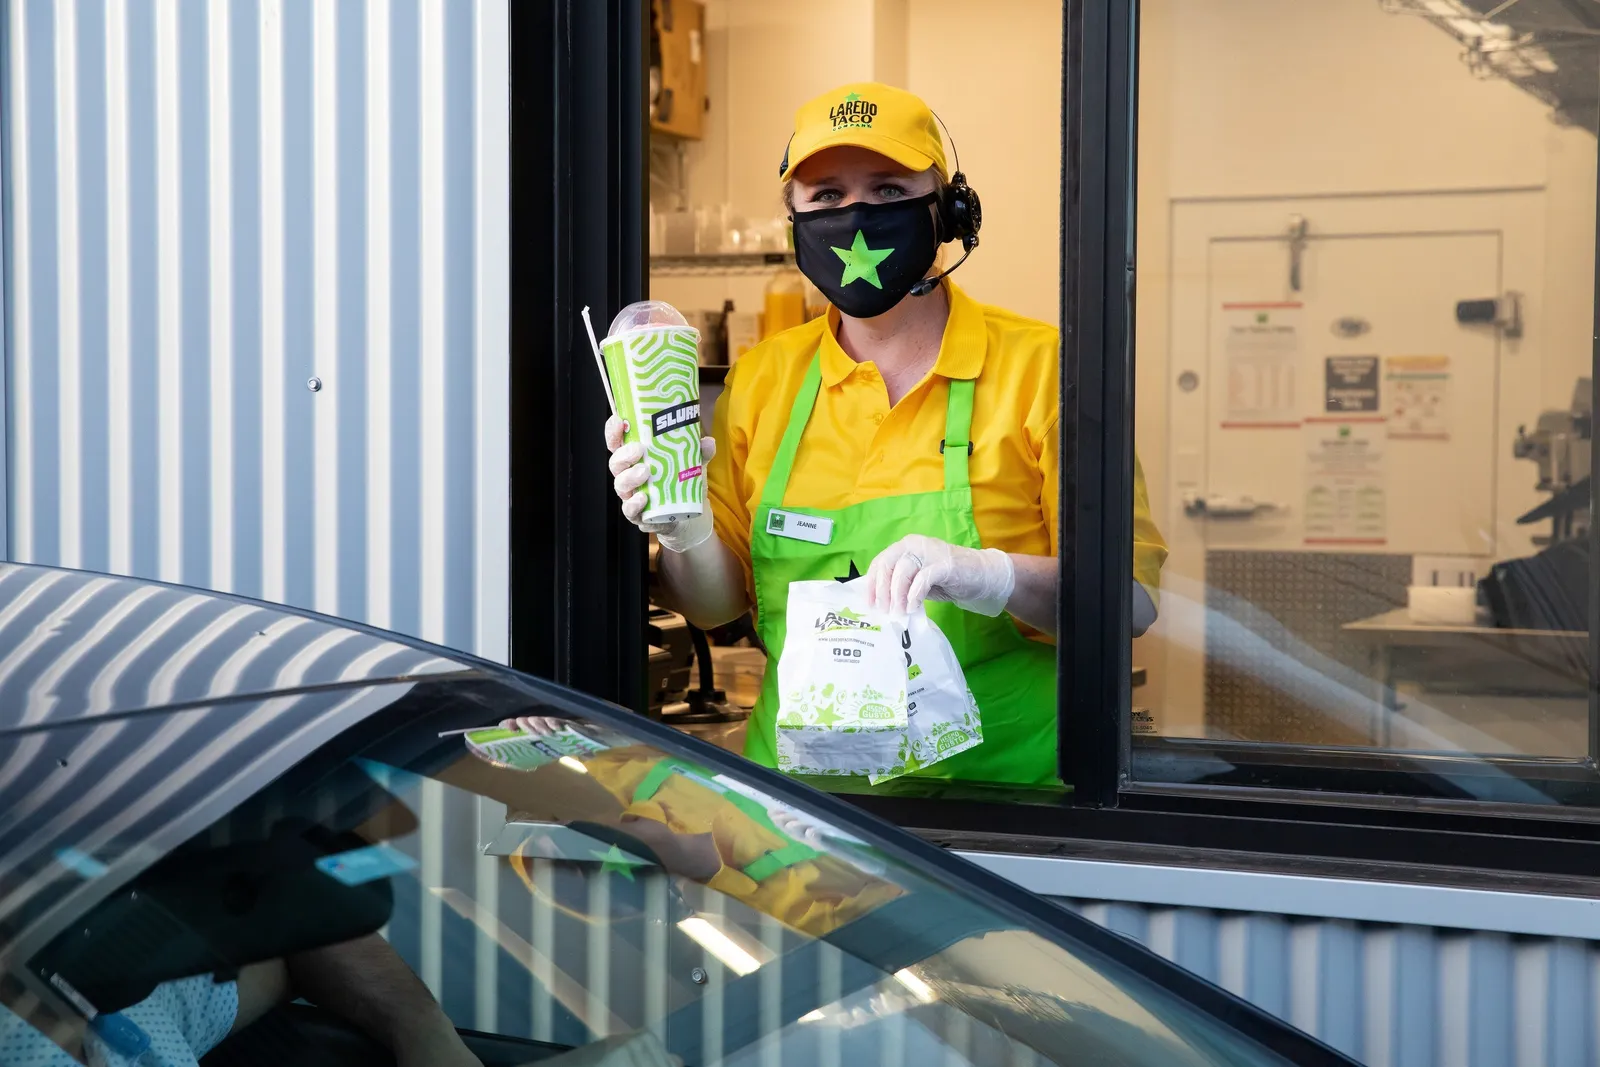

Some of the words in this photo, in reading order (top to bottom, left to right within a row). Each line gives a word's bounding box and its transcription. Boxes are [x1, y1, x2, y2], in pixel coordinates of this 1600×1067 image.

[829, 101, 877, 118] LAREDO
[830, 114, 873, 127] TACO
[797, 521, 817, 529] JEANNE
[862, 709, 891, 718] GUSTO
[939, 735, 965, 751] GUSTO
